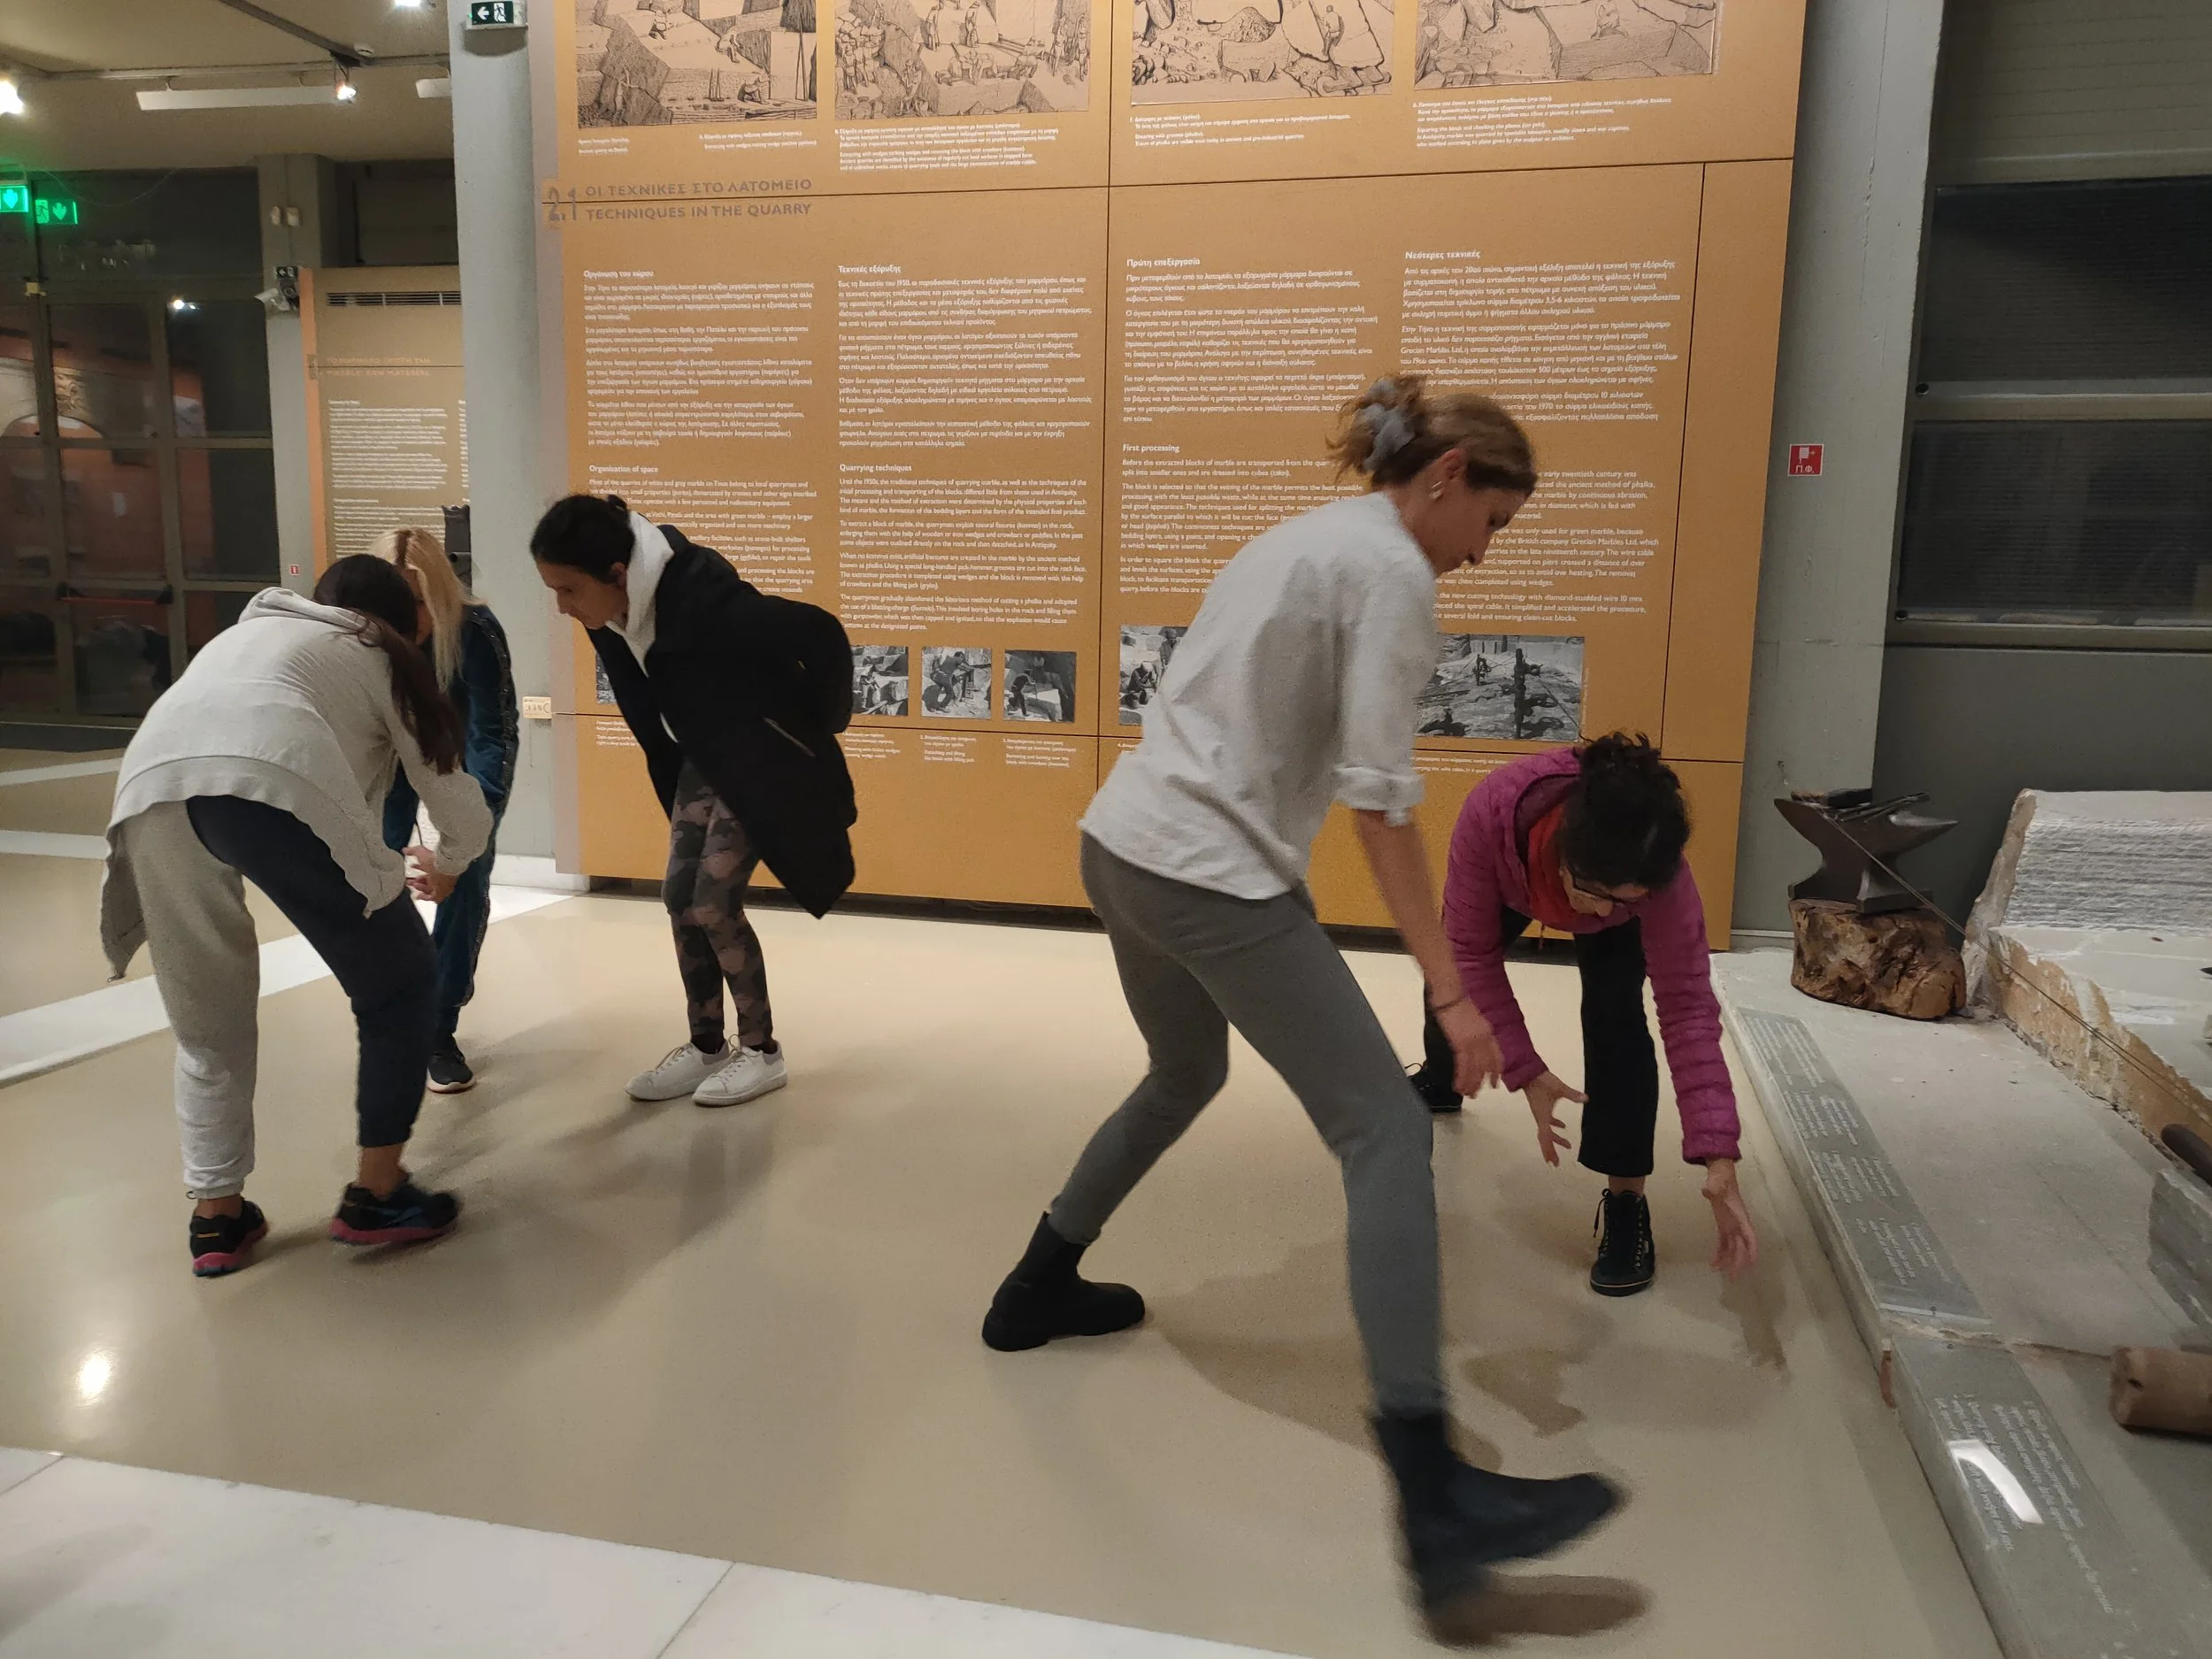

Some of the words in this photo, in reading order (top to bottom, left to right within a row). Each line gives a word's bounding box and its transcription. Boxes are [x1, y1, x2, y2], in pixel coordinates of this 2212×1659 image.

[586, 186, 605, 198] ΟΙ
[608, 185, 684, 196] ΤΕΧΝΙΚΕΣ
[694, 182, 724, 194] ΣΤΟ
[729, 180, 811, 191] ΛΑΤΟΜΕΙΟ
[588, 208, 686, 220] TECHNIQUES
[692, 207, 708, 217] IN
[714, 205, 741, 217] THE
[748, 204, 810, 217] QUARRY
[589, 465, 631, 474] Organization
[840, 464, 874, 473] Quarrying
[1795, 465, 1814, 473] Π.Φ.
